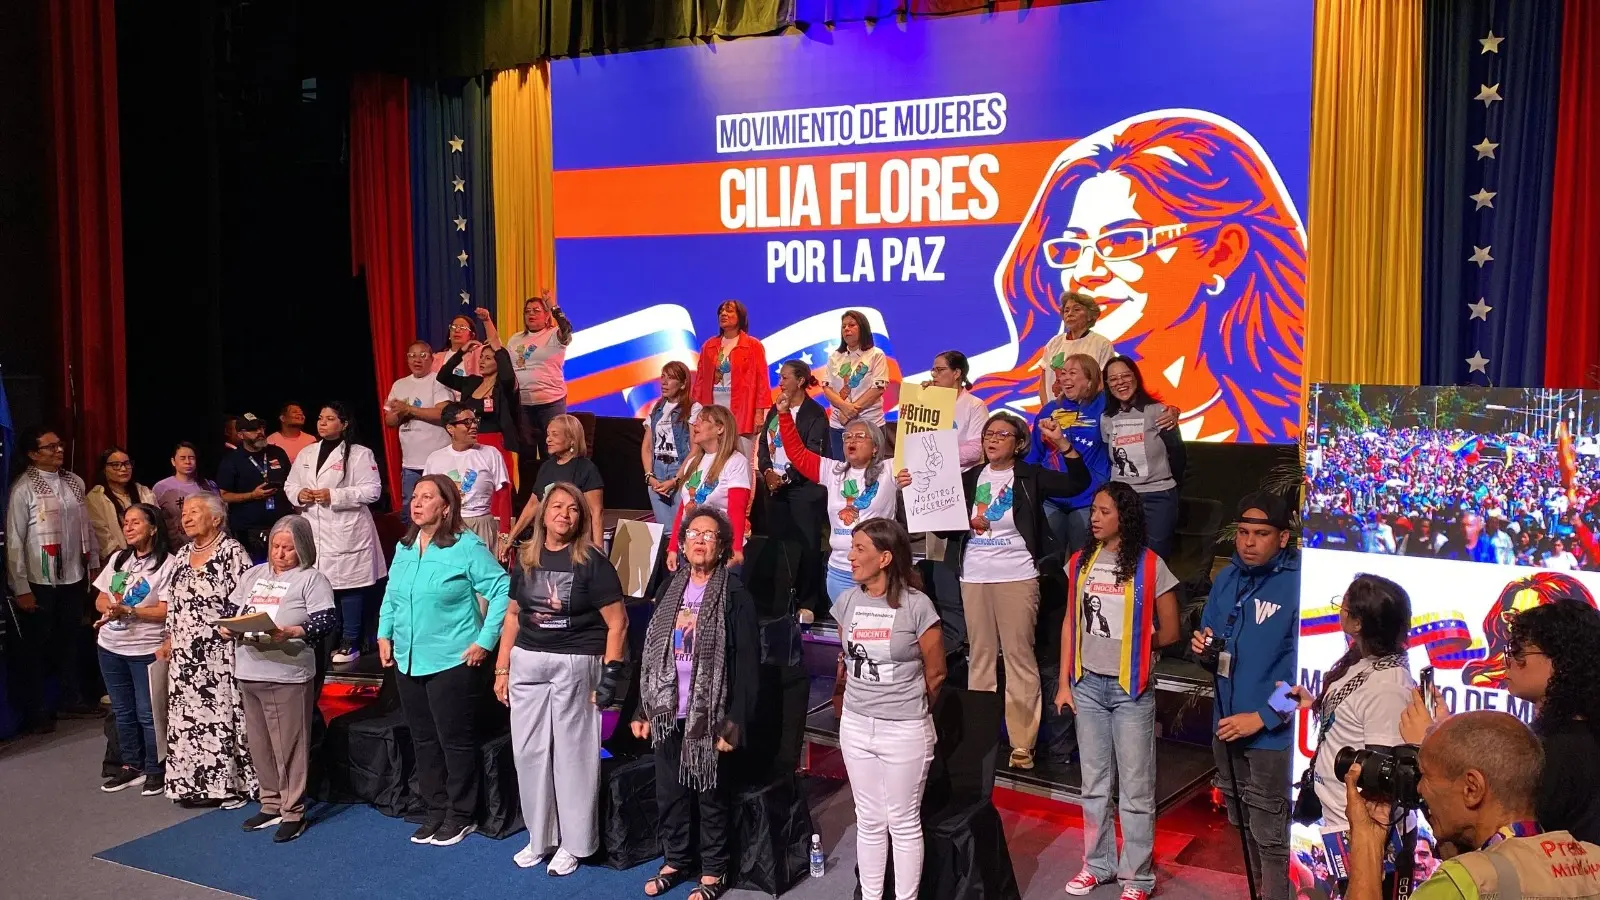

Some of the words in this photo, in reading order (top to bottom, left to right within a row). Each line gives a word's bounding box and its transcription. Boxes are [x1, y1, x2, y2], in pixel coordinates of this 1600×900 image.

[720, 109, 852, 149] MOVIMIENTO
[859, 106, 888, 140] DE
[894, 97, 1002, 137] MUJERES
[720, 164, 821, 230] CILIA
[830, 153, 999, 226] FLORES
[767, 240, 826, 284] POR
[833, 238, 876, 283] LA
[882, 236, 946, 283] PAZ
[900, 403, 941, 427] #Bring
[909, 494, 960, 517] VENCEREMOS
[914, 485, 956, 505] NOSOTROS
[856, 630, 888, 640] INOCENTE
[1465, 688, 1499, 712] DE
[1398, 876, 1410, 900] EOS
